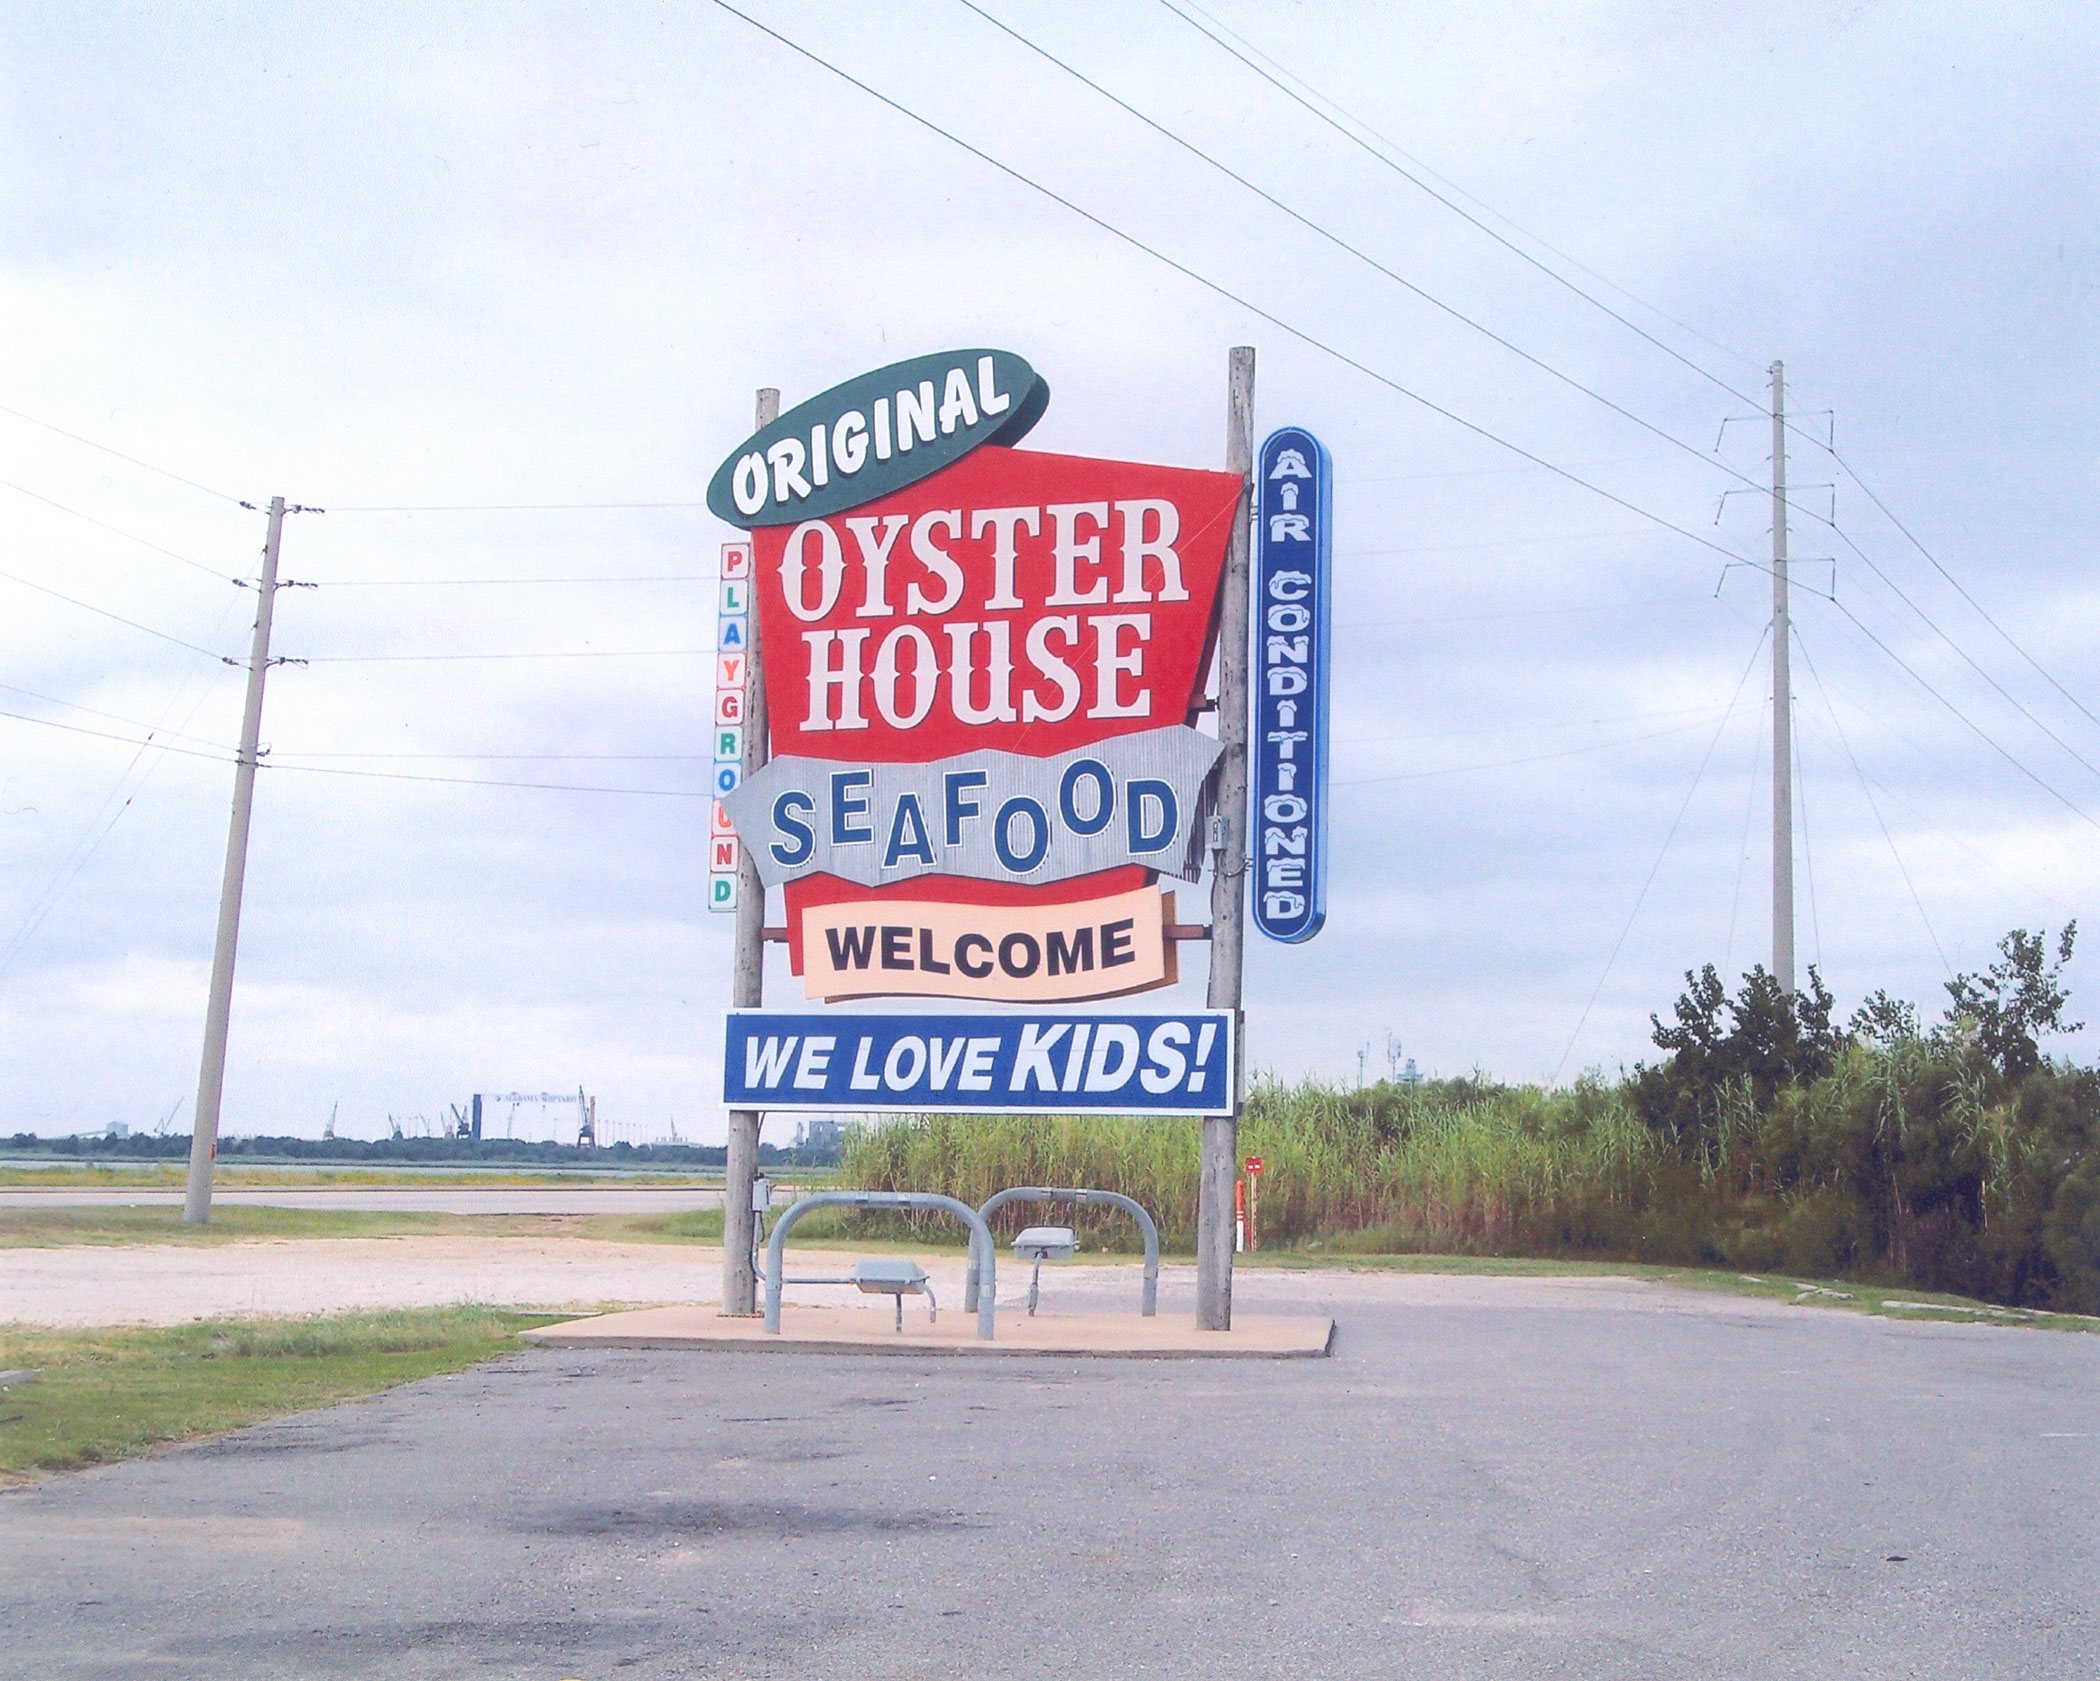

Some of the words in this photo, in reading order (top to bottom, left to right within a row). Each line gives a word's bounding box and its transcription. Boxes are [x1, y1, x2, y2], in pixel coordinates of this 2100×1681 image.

[732, 355, 1010, 516] ORIGINAL
[1268, 448, 1313, 542] AIR
[776, 499, 1189, 622] OYSTER
[799, 612, 1152, 732] HOUSE
[1263, 570, 1312, 919] CONDITIONED
[767, 757, 1180, 875] SEAFOOD
[825, 918, 1136, 979] WELCOME
[744, 1036, 835, 1090] WE
[849, 1036, 1001, 1091] LOVE
[1007, 1022, 1216, 1093] KIDS!
